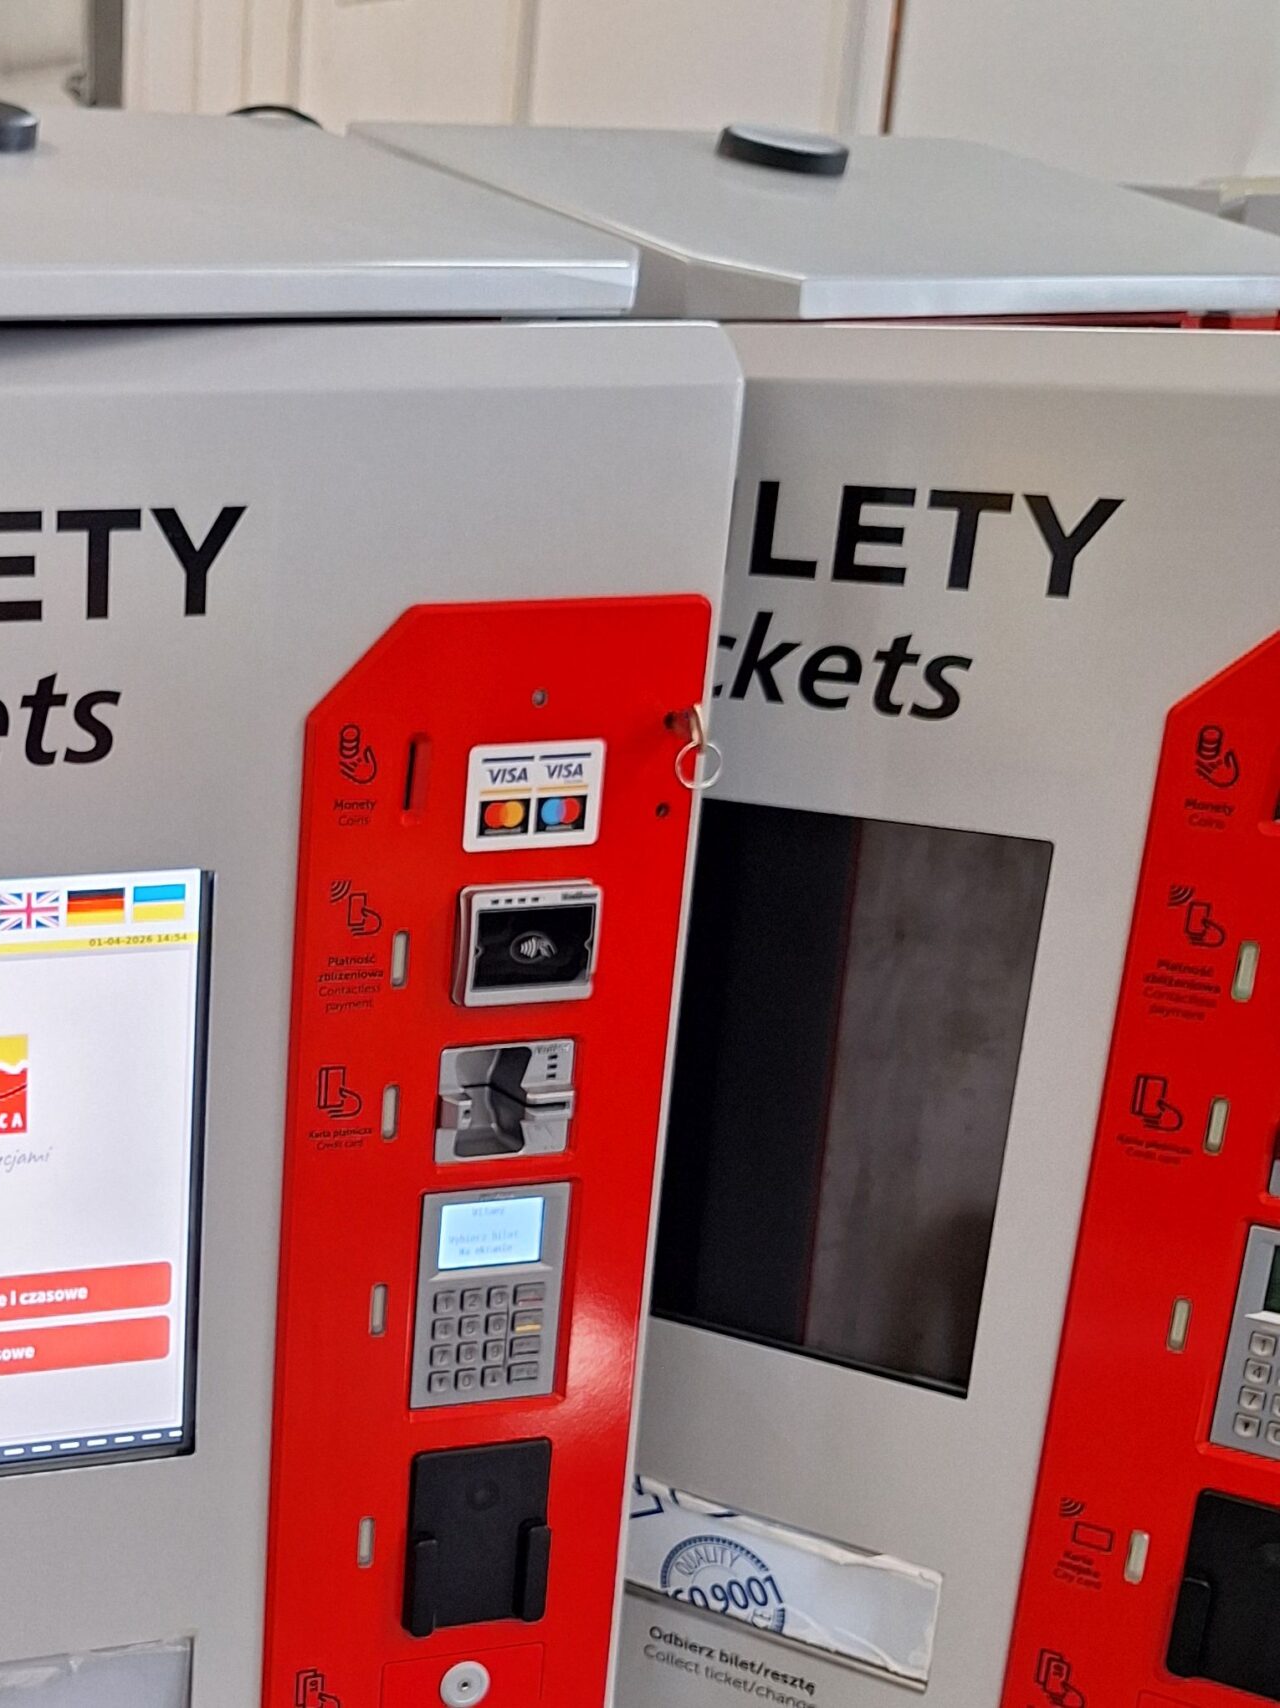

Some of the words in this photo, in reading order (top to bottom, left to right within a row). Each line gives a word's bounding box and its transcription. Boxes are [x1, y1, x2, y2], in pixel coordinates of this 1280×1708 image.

[488, 767, 529, 784] VISA
[545, 763, 584, 779] VISA
[89, 936, 153, 947] 01-04-2026
[157, 932, 187, 942] 14:54
[19, 1287, 88, 1304] czasowe
[675, 1545, 741, 1576] QUALITY
[643, 1644, 700, 1675] Collect
[649, 1626, 715, 1658] Odbierz
[719, 1650, 816, 1696] bilet/resztę
